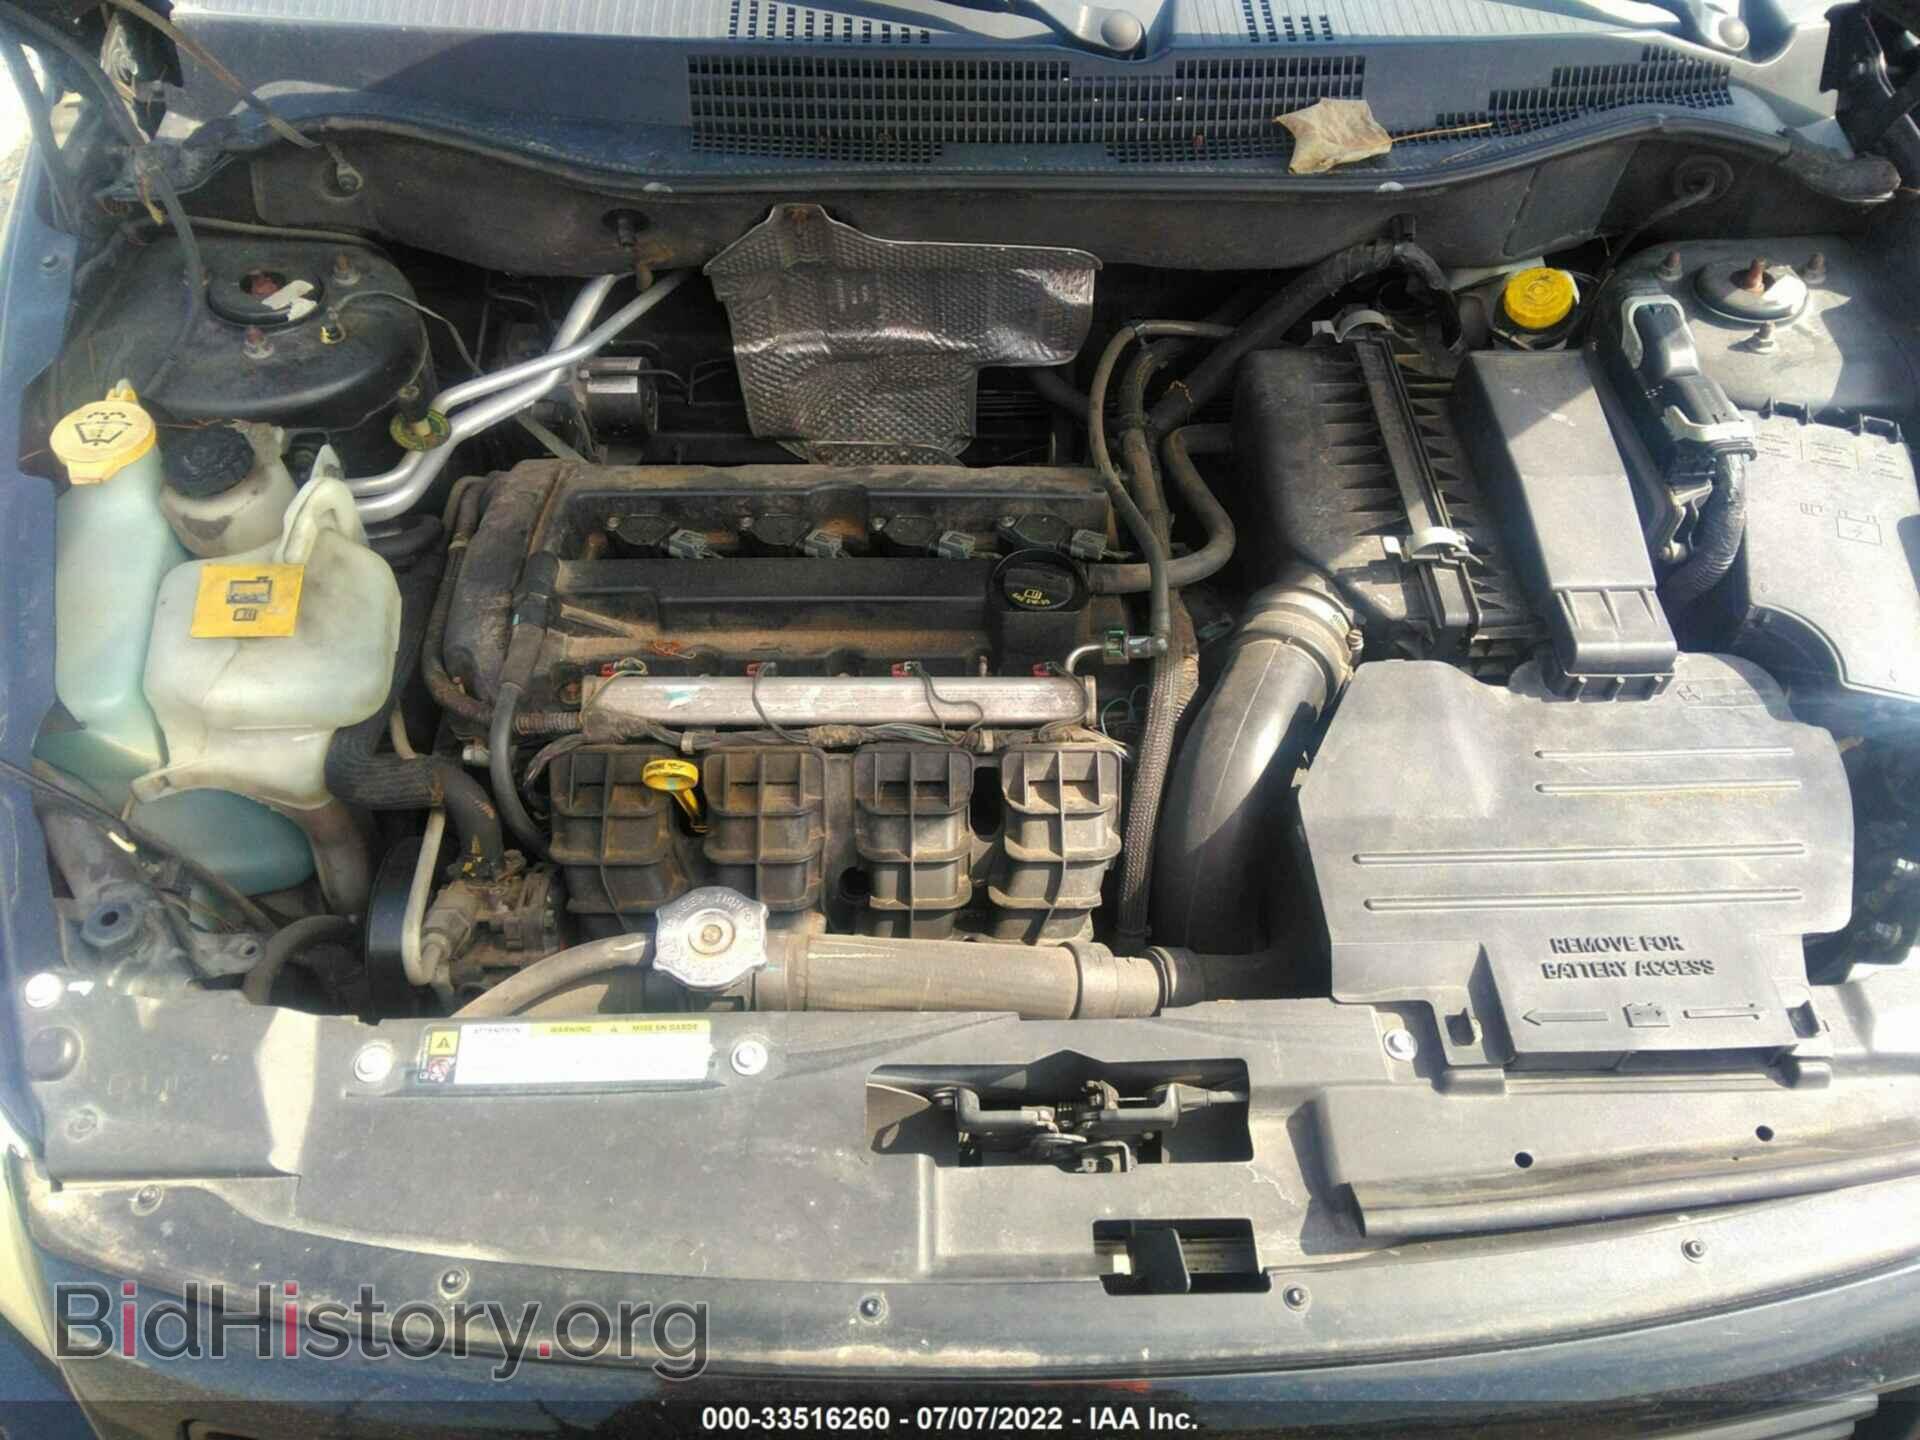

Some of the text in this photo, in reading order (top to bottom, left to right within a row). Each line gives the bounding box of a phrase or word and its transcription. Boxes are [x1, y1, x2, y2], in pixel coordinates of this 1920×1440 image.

[1550, 934, 1684, 953] REMOVE FOR
[1540, 959, 1715, 979] BATTERY ACCESS
